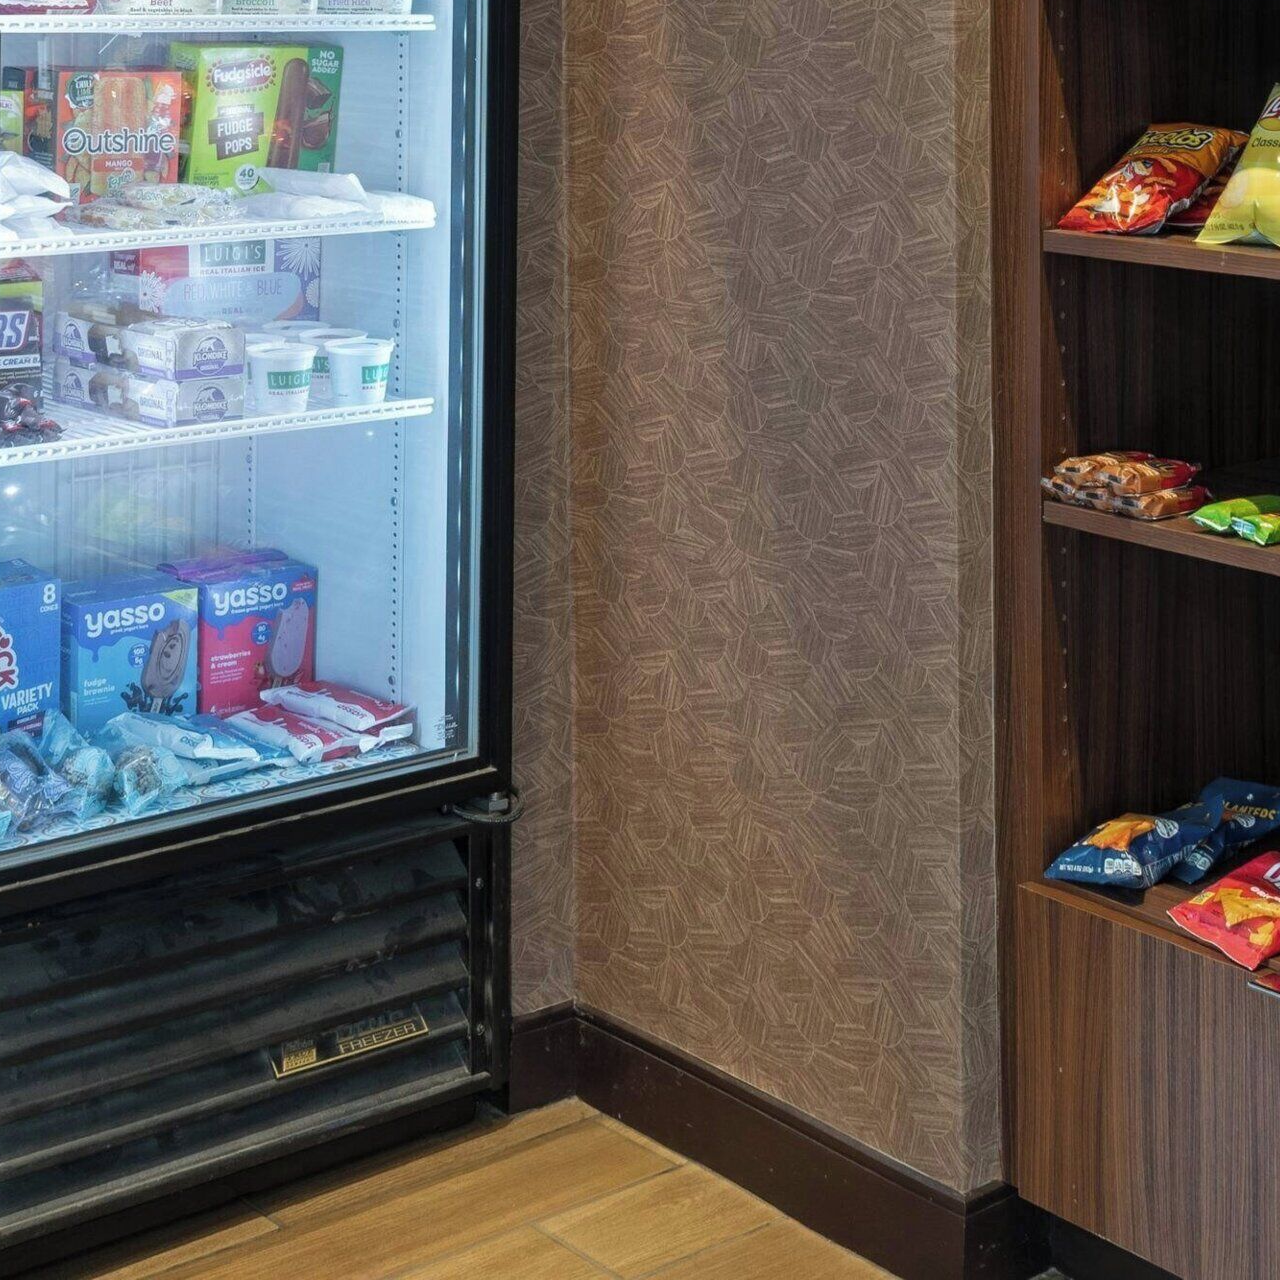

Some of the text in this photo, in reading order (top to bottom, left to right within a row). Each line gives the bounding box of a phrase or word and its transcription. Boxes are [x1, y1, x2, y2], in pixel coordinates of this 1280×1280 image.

[311, 59, 339, 67] SUGAR
[319, 51, 335, 59] NO
[217, 119, 253, 137] FUDGE
[62, 126, 176, 155] Outshine
[225, 137, 252, 154] POPS
[203, 244, 264, 262] LUIGI'S
[256, 279, 283, 296] BLUE
[193, 350, 228, 365] KLONDIKE
[43, 583, 56, 603] 8
[213, 583, 288, 616] yasso
[85, 601, 165, 639] yasso
[210, 650, 251, 662] strawberries
[1, 682, 53, 711] VARIETY
[84, 686, 115, 696] brownie
[17, 703, 39, 716] PACK
[339, 1022, 416, 1054] FREEZER
